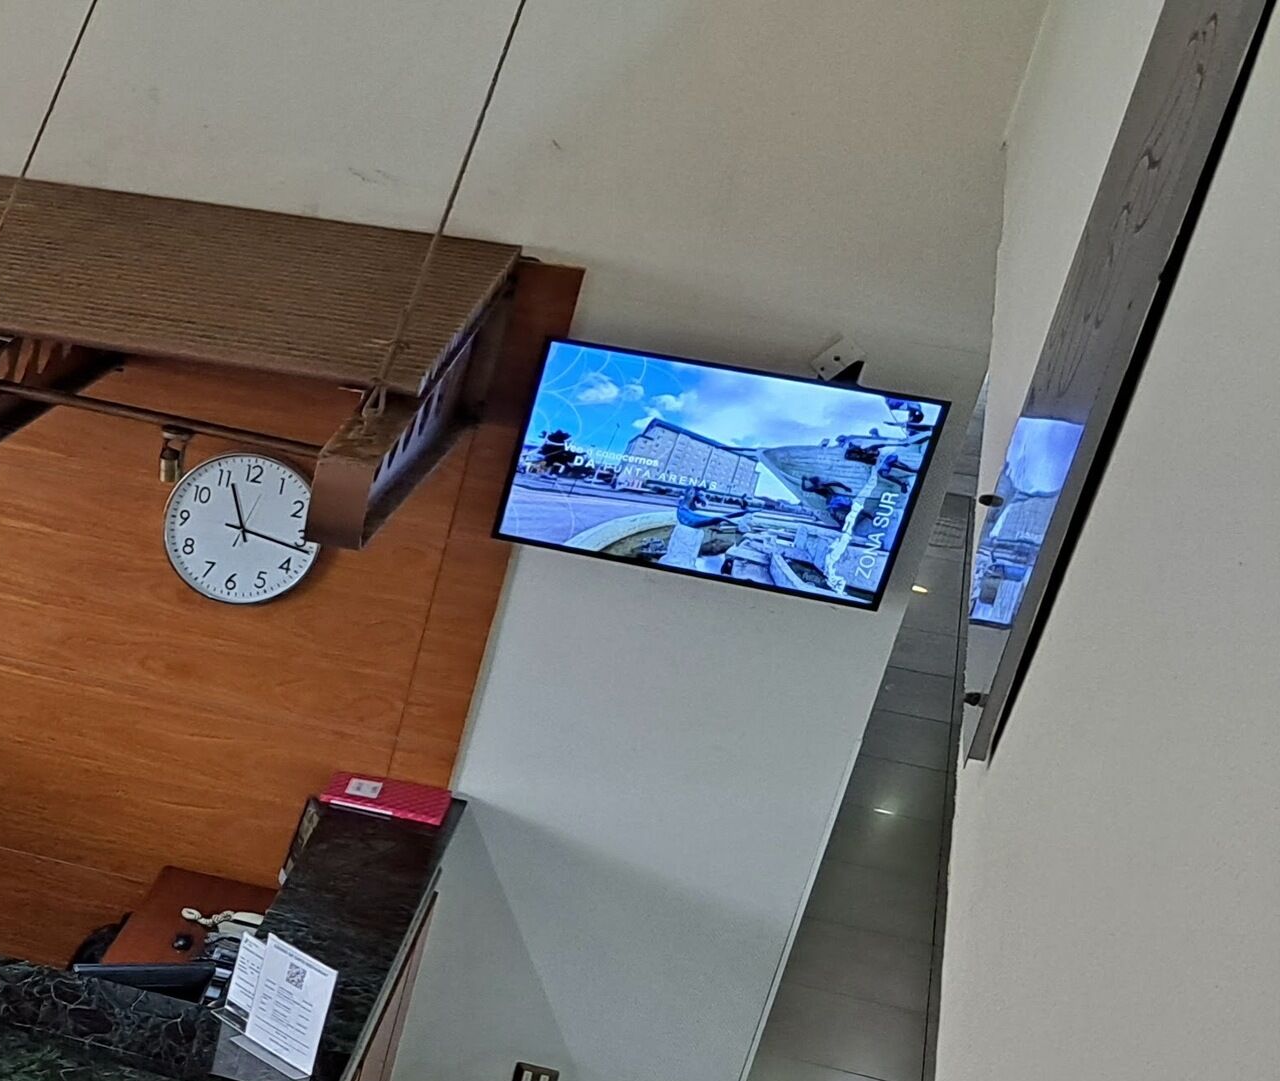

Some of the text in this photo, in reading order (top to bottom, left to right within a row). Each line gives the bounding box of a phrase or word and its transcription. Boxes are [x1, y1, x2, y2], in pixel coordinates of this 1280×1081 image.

[595, 450, 660, 468] conocernos
[217, 469, 232, 488] 11
[245, 464, 264, 484] 12
[573, 455, 719, 490] DA PUNTA ARENAS
[193, 485, 212, 504] 10
[279, 478, 285, 495] 1
[179, 509, 191, 526] 9
[290, 500, 305, 519] 2
[294, 530, 306, 548] 3
[854, 492, 900, 580] ZONA SUR
[182, 537, 195, 555] 8
[202, 561, 216, 578] 7
[278, 556, 292, 575] 4
[225, 573, 237, 590] 6
[254, 571, 267, 589] 5
